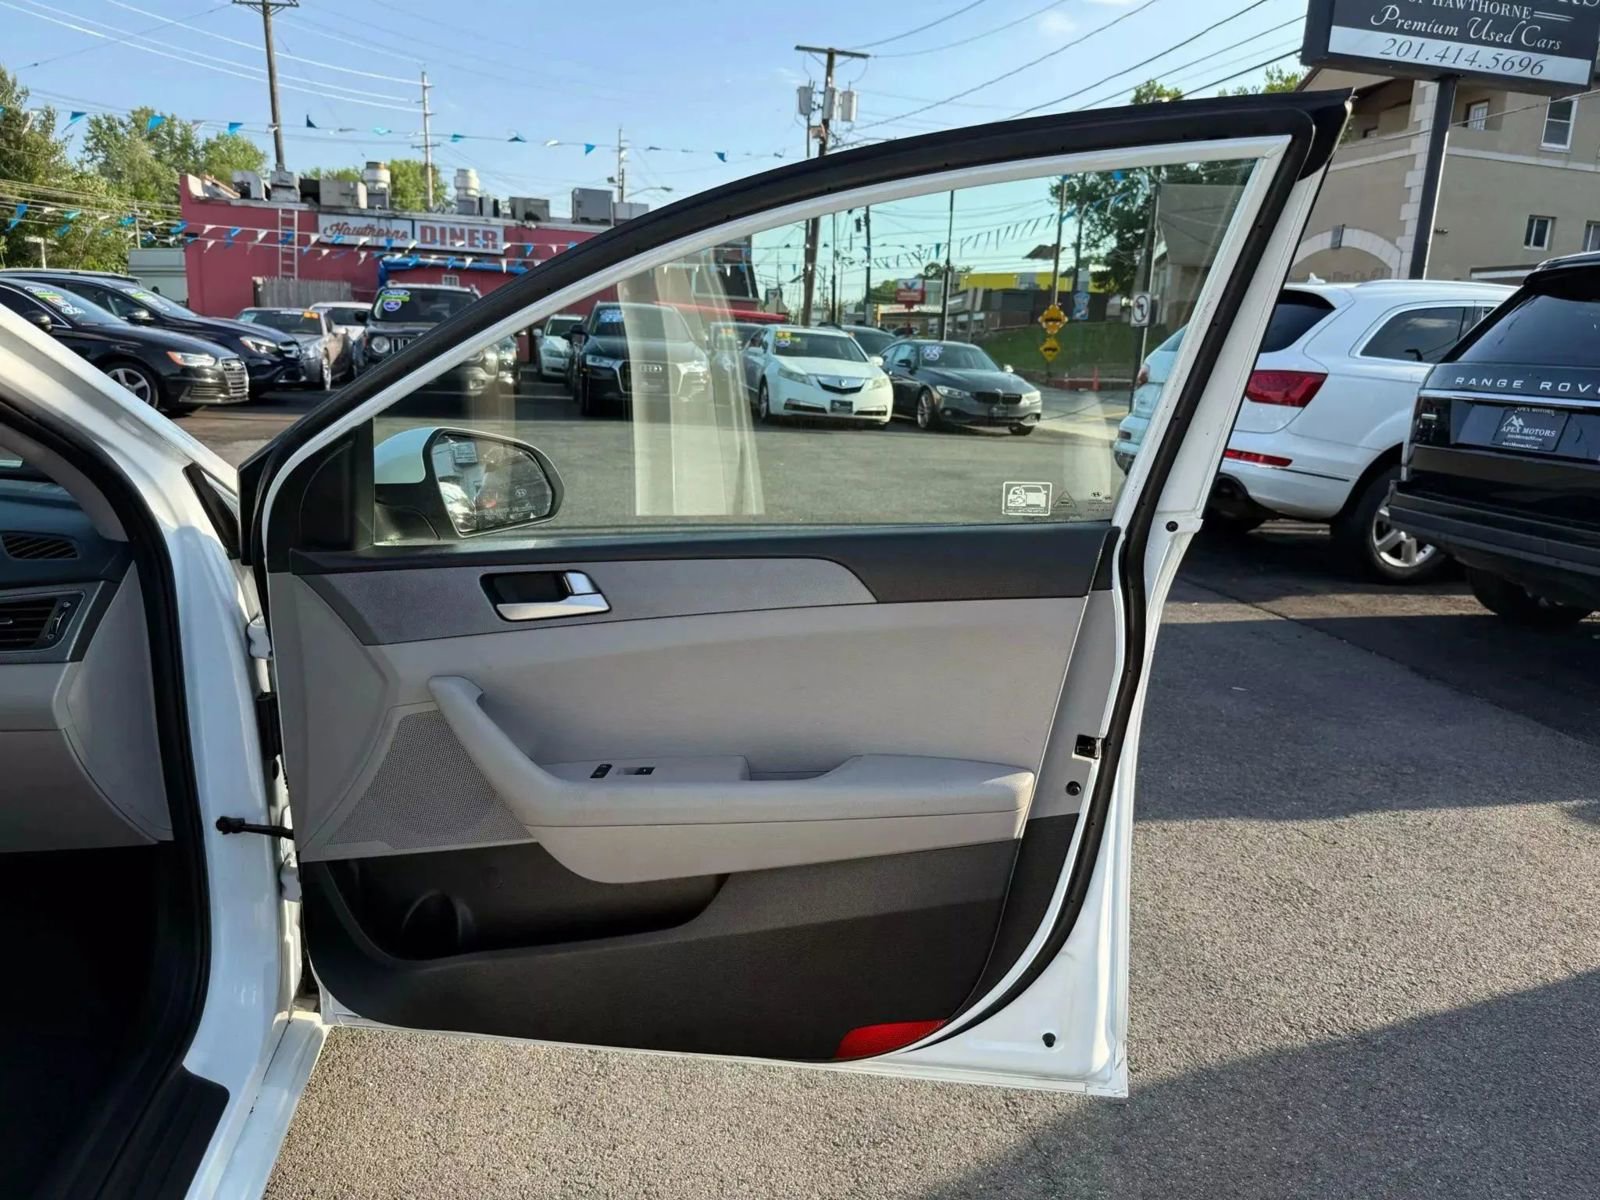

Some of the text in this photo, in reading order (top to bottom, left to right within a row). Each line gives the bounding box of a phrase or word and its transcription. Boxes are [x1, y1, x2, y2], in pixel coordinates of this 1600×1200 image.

[1370, 4, 1563, 51] Premium Used Cars
[1379, 37, 1548, 77] 201.414.5696
[419, 224, 499, 250] DINER
[1454, 376, 1600, 393] RANGE ROV
[1501, 425, 1522, 434] APEX
[1522, 427, 1556, 438] MOTORS
